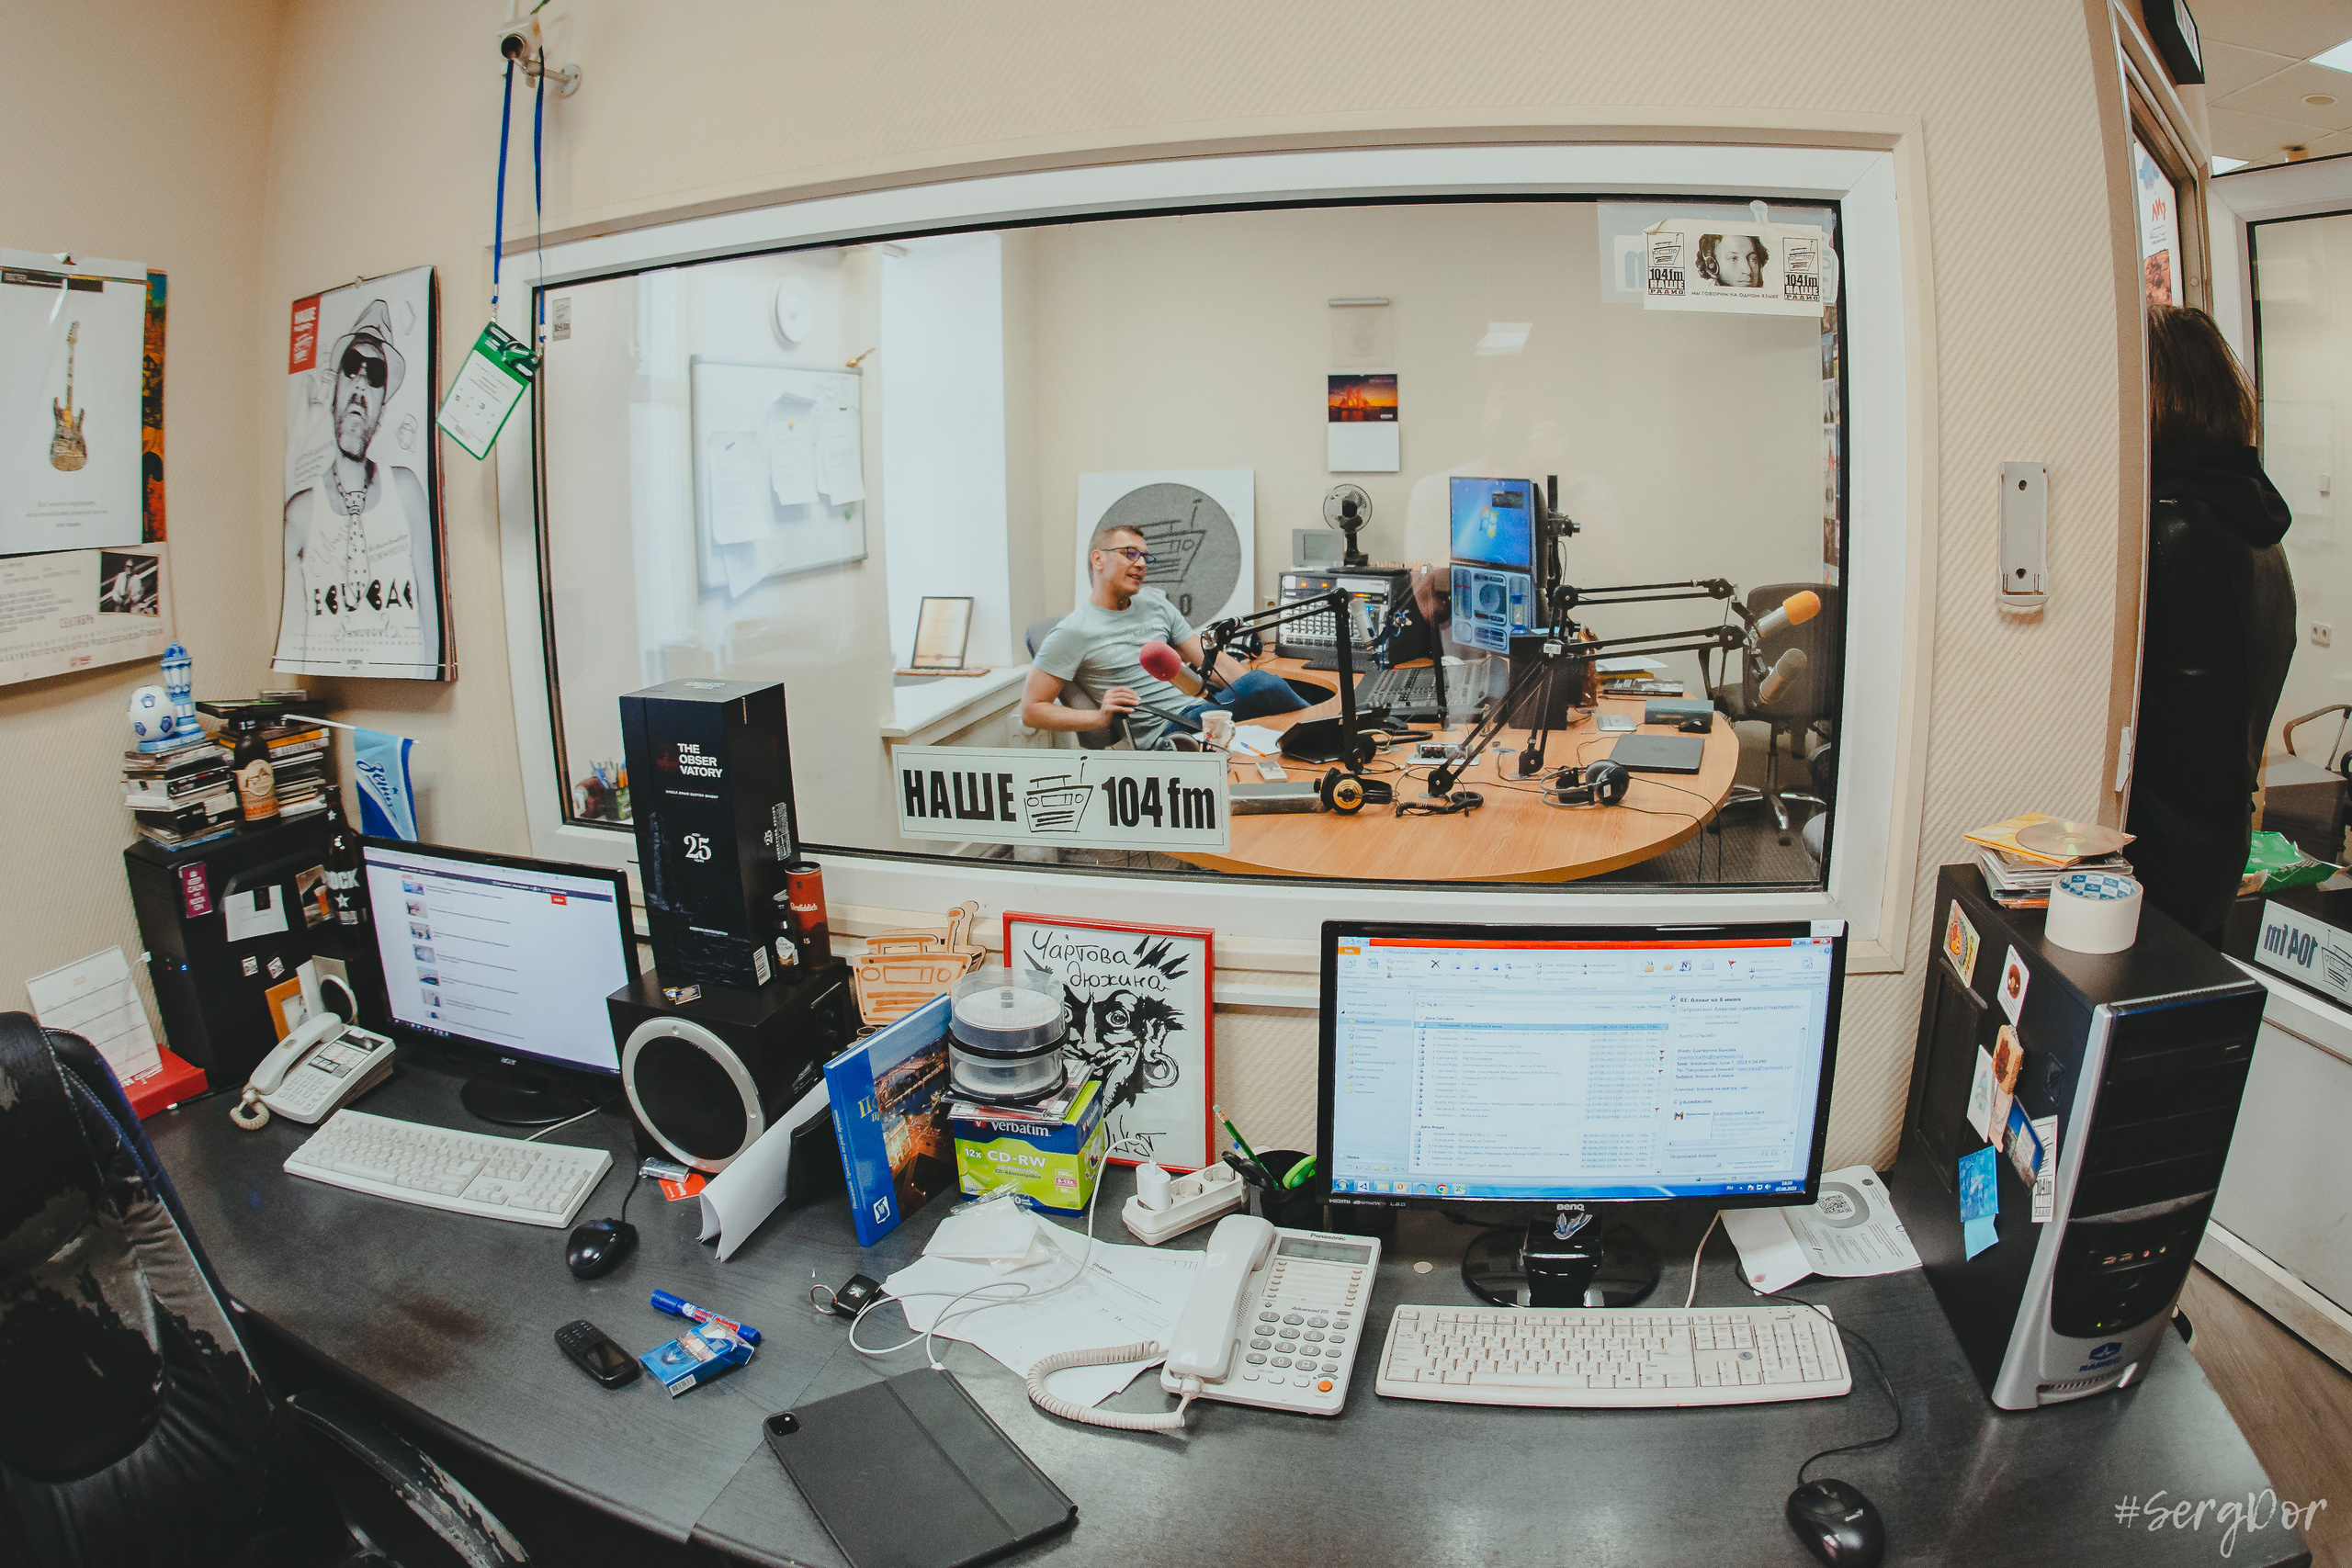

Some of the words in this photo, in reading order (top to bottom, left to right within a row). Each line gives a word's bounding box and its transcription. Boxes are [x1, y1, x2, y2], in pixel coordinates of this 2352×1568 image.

[677, 742, 700, 753] THE
[679, 754, 717, 766] OBSER
[680, 765, 722, 778] VATORY
[902, 769, 1017, 822] НАШЕ
[684, 835, 711, 860] 25
[965, 1148, 982, 1159] 12x
[987, 1150, 1047, 1168] CD-RW
[1556, 1203, 1585, 1212] BenQ
[1310, 1233, 1347, 1241] Panasonic
